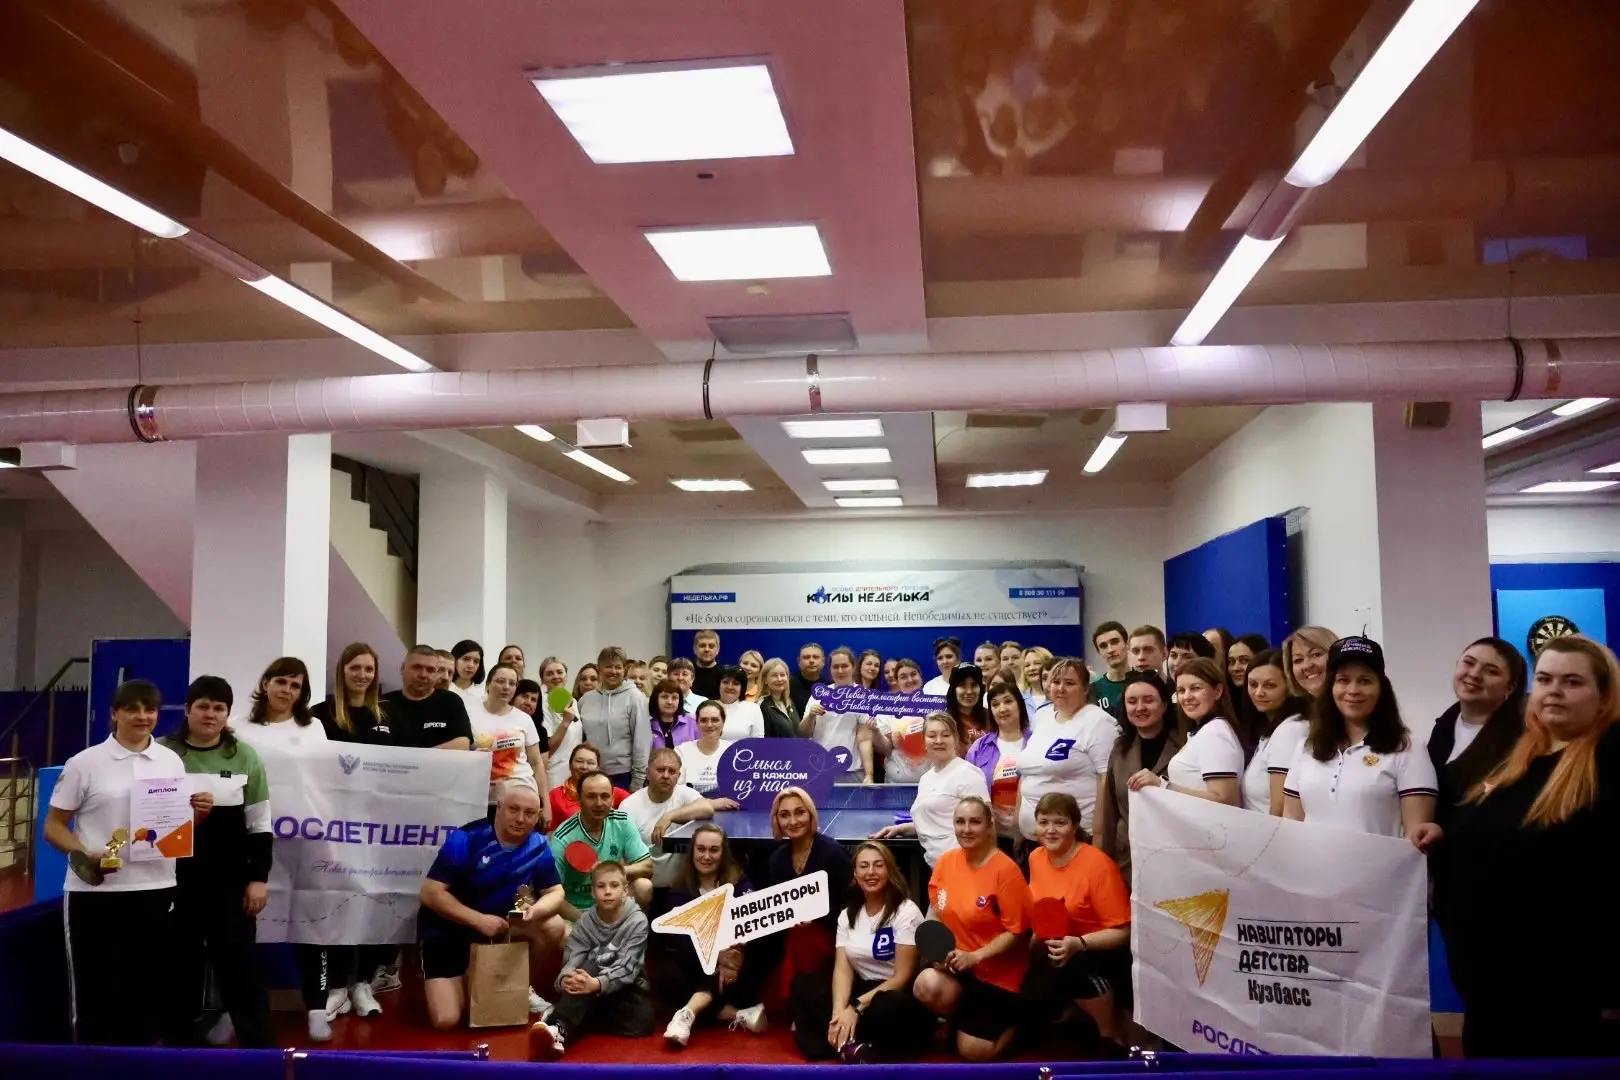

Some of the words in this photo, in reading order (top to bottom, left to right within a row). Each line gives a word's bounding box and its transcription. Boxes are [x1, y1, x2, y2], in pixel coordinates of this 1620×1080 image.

[683, 593, 729, 602] НЕДЕЛЬКА.РФ
[858, 591, 930, 602] НЕДЕЛЬКА
[685, 612, 703, 624] «Не
[705, 611, 733, 624] бойся
[735, 613, 803, 626] соревноваться
[841, 613, 858, 623] кто
[903, 610, 975, 623] Непобедимых
[975, 611, 985, 621] не
[987, 609, 1048, 622] существует»
[814, 685, 830, 698] От
[831, 687, 867, 700] Новой
[867, 692, 910, 705] философии
[1098, 696, 1110, 709] 10
[835, 699, 871, 711] Новой
[871, 703, 914, 716] философии
[732, 748, 792, 772] Смысл
[762, 772, 808, 780] КАЖДОМ
[147, 787, 178, 795] ДИПЛОМ
[733, 780, 756, 800] из
[759, 780, 790, 793] нас
[730, 881, 820, 921] НАВИГАТОРЫ
[734, 907, 795, 939] ДЕТСТВА
[1236, 923, 1343, 947] НАВИГАТОРЫ
[1238, 949, 1310, 974] ДЕТСТВА
[1247, 979, 1313, 1007] Кузбасс
